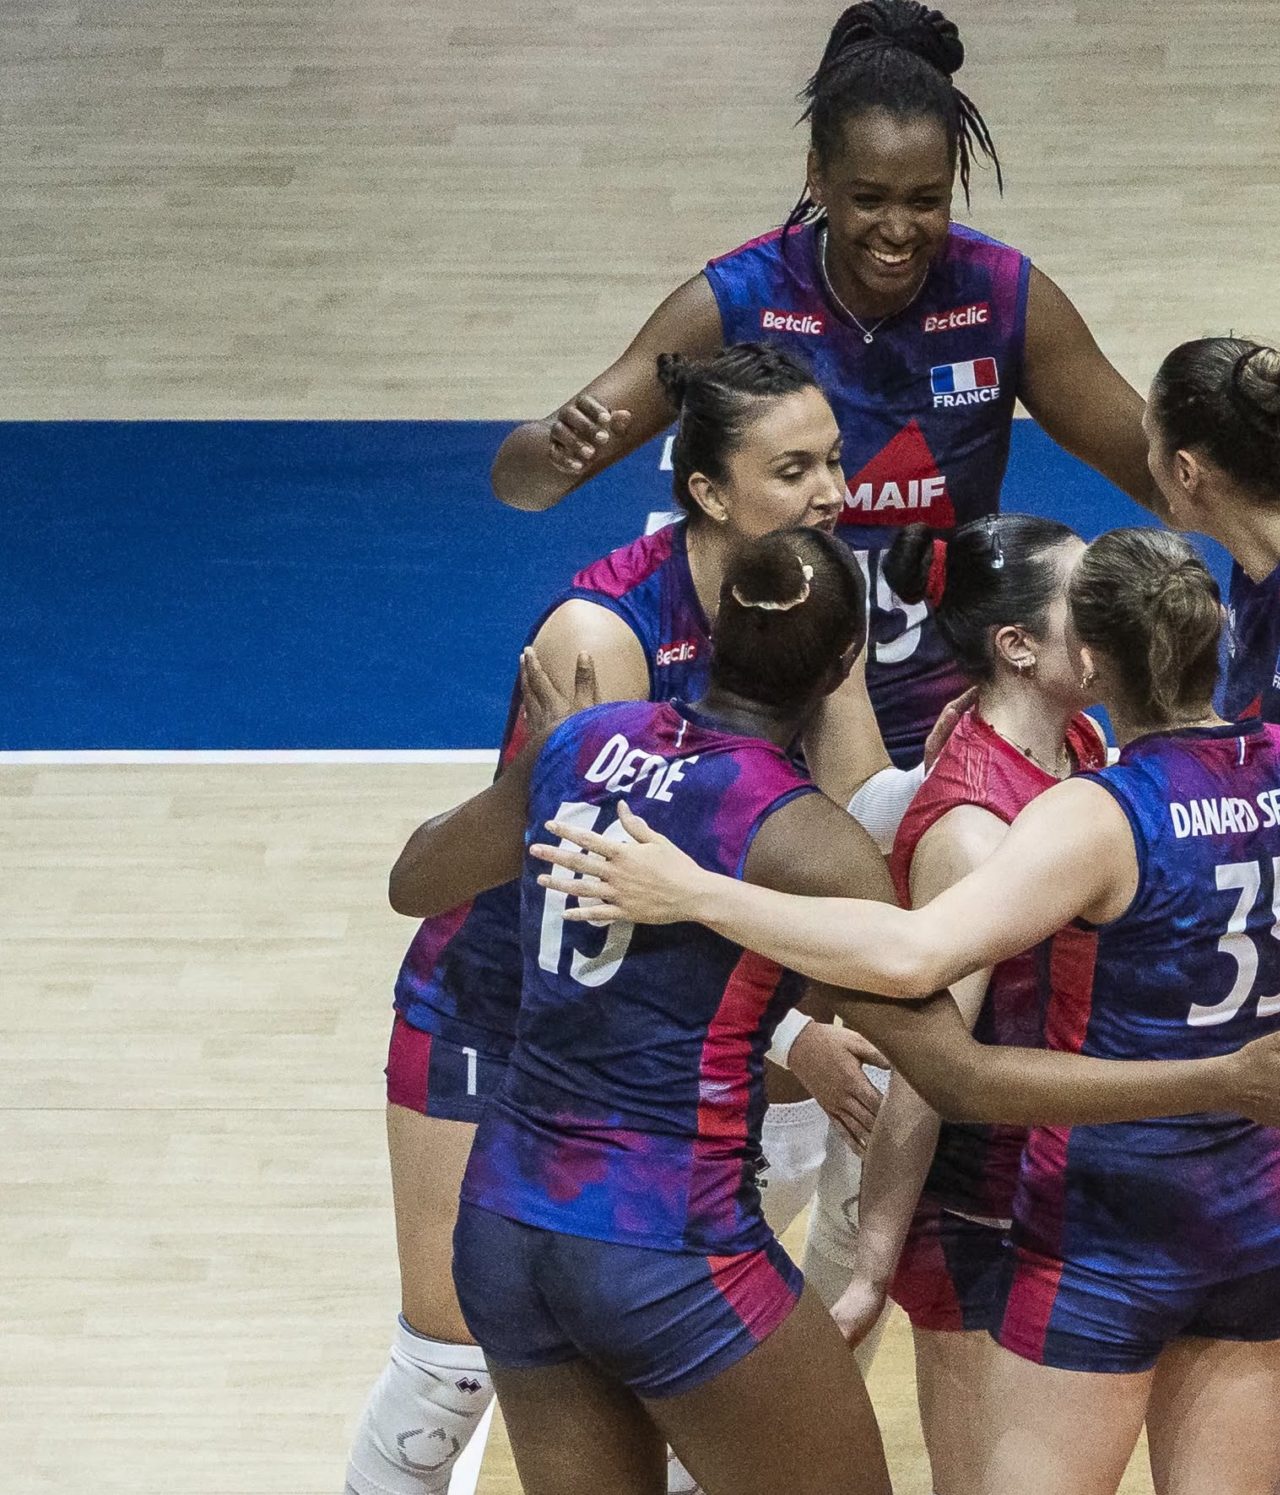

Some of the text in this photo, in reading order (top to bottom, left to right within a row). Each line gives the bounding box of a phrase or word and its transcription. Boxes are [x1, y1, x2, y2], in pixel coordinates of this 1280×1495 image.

[763, 311, 822, 334] Betclic
[924, 306, 988, 332] Betclic
[933, 387, 1000, 408] FRANCE
[839, 475, 946, 512] MAIF
[656, 641, 696, 666] Beclic
[1169, 797, 1259, 838] DANARD
[462, 1047, 477, 1096] 1
